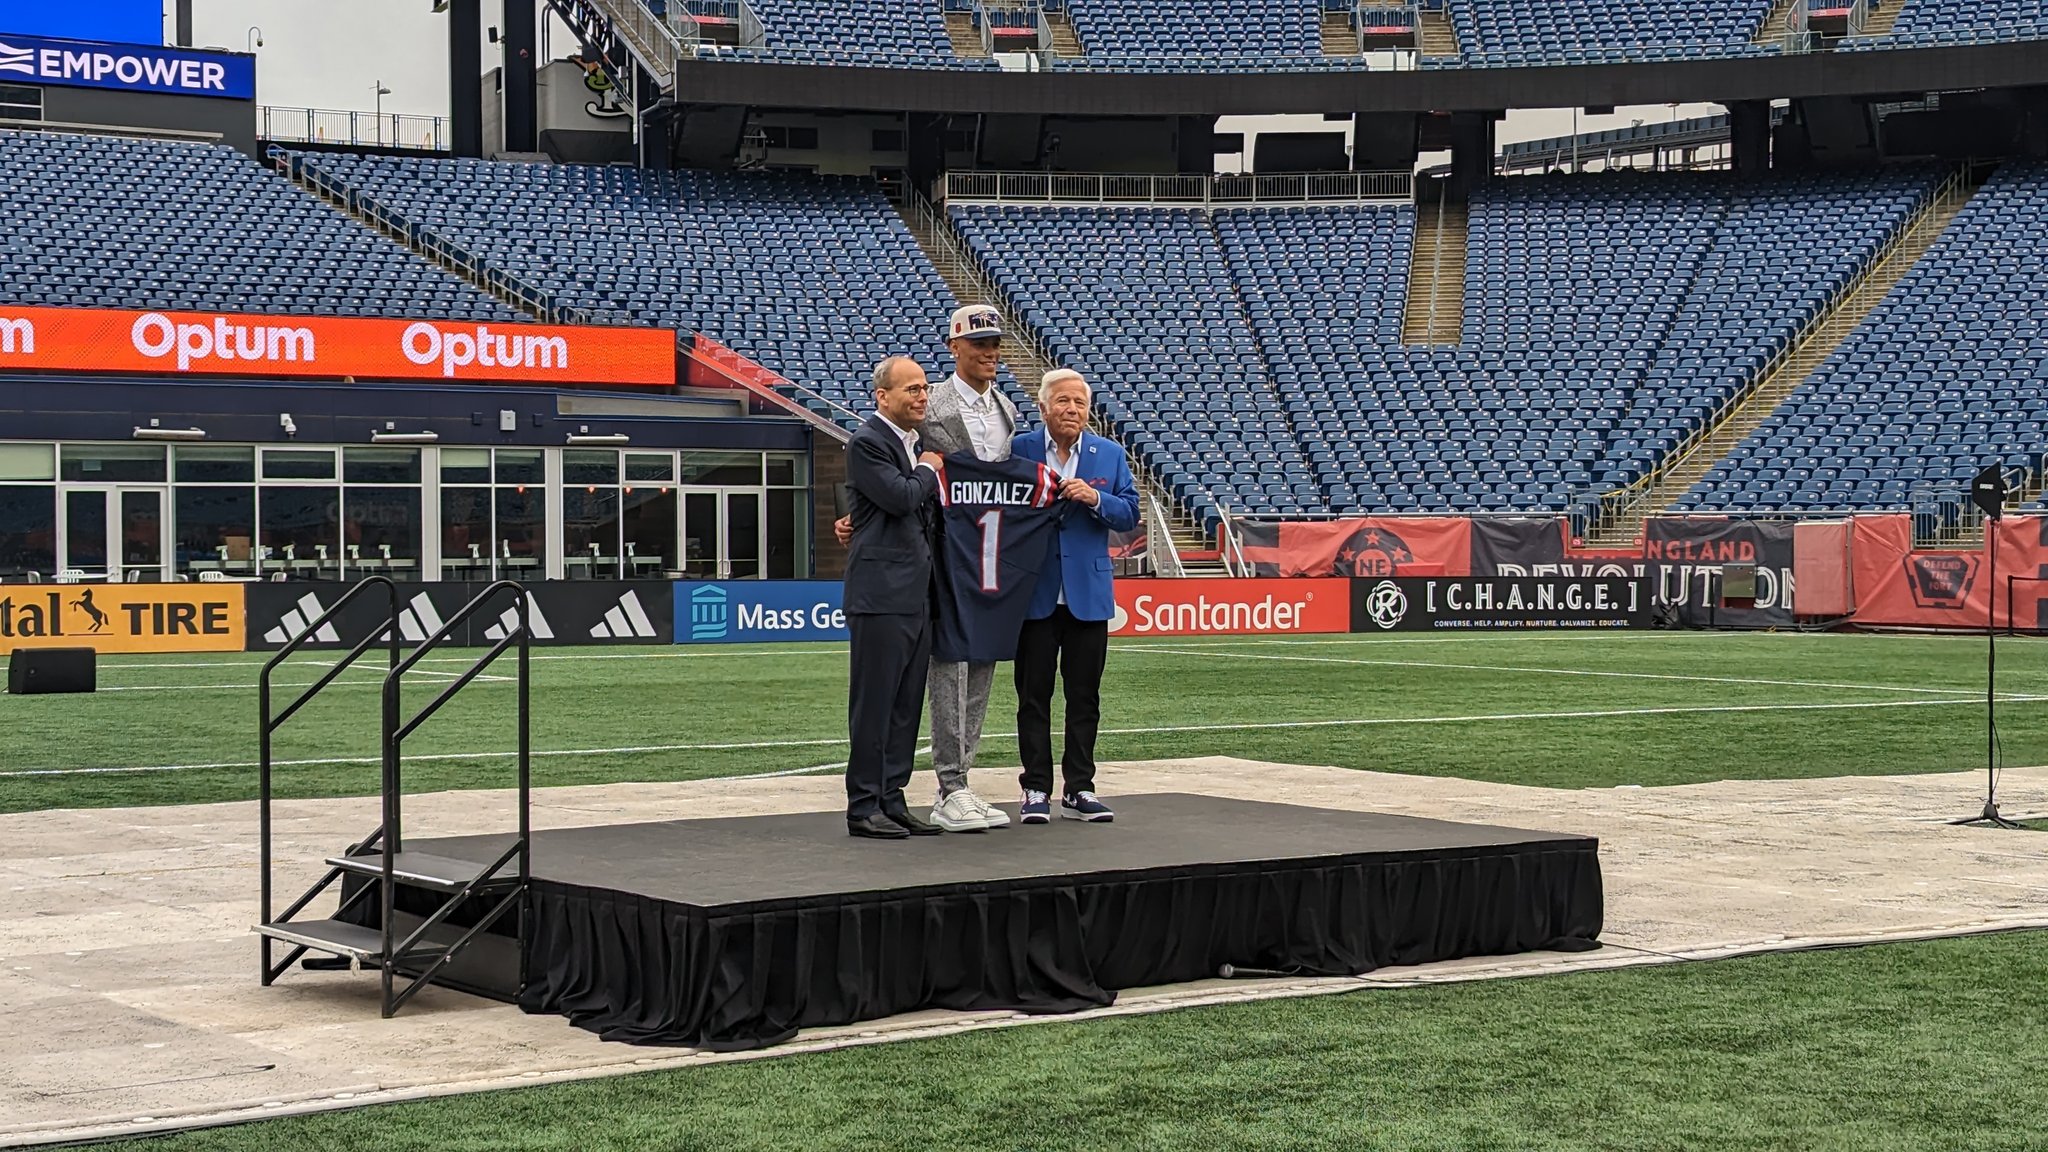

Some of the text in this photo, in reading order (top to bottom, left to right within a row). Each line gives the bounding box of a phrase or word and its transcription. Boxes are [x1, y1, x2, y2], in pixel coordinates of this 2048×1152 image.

[40, 48, 225, 90] EMPOWER
[131, 312, 315, 371] Optum
[402, 322, 567, 376] Optum
[951, 481, 1034, 505] GONZALEZ
[977, 508, 1003, 592] 1
[1647, 539, 1756, 561] NGLAND
[121, 602, 230, 636] TIRE
[738, 603, 805, 630] Mass
